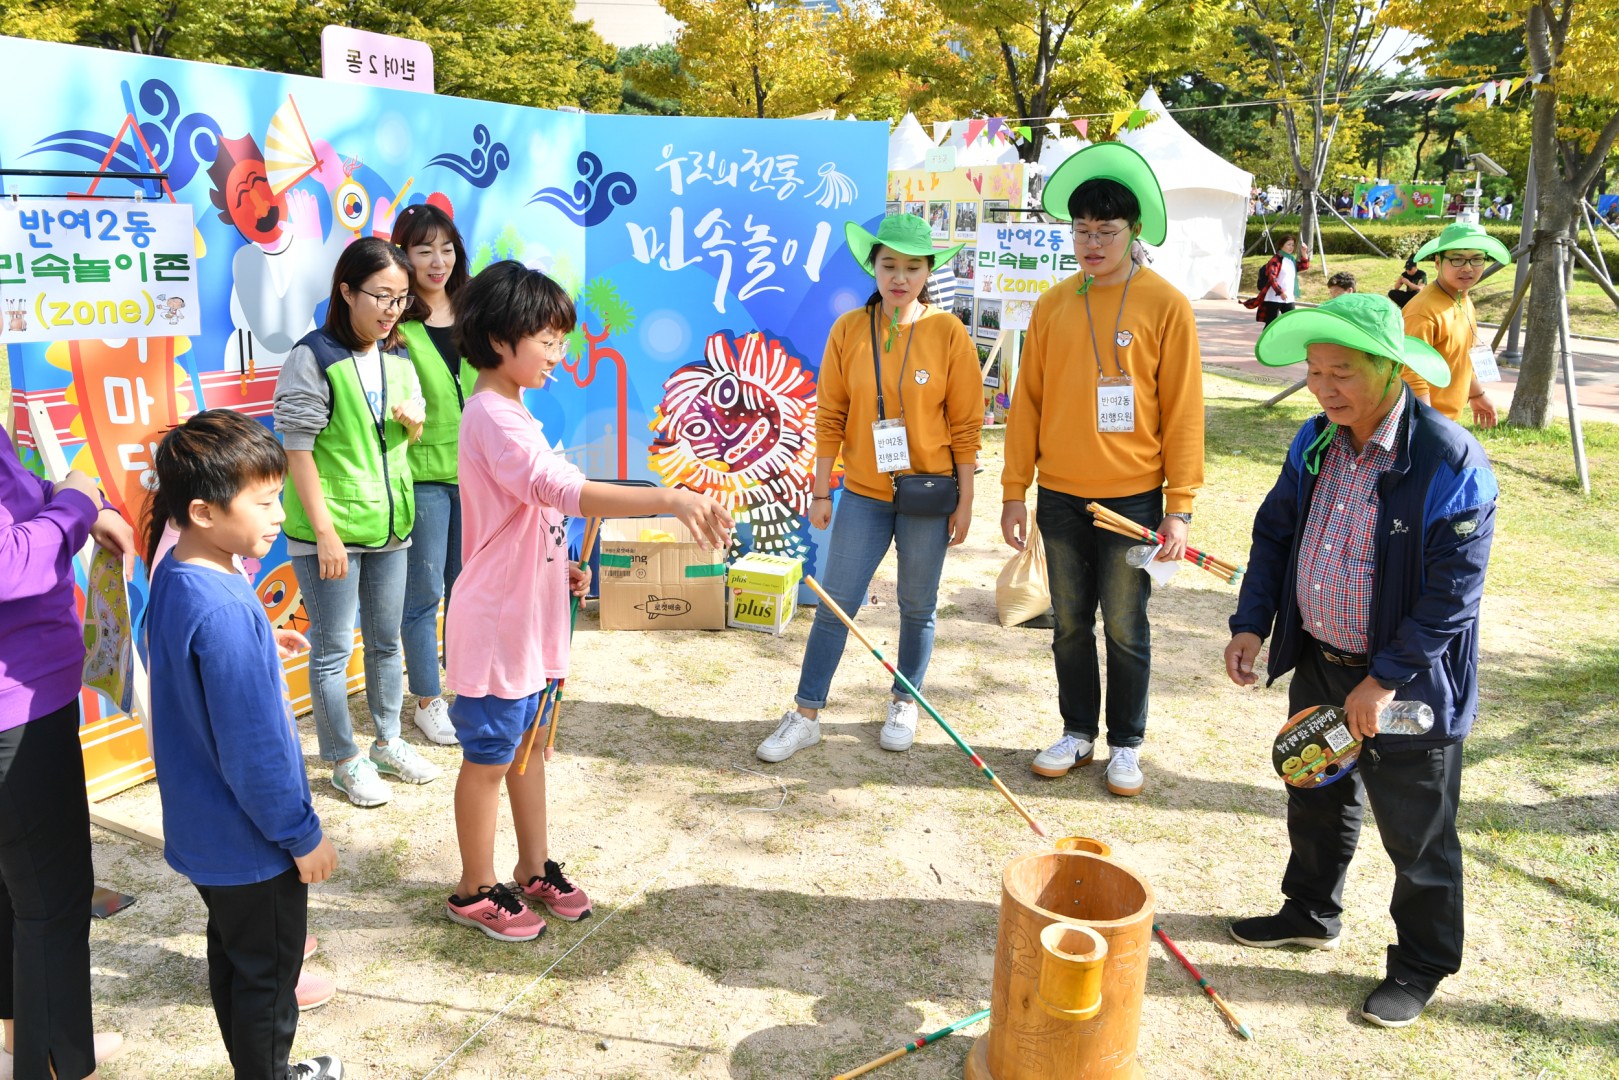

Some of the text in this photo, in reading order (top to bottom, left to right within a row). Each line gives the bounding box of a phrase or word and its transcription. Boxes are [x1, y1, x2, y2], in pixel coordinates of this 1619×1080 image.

[19, 209, 156, 248] 반여2동
[997, 228, 1064, 251] 반여2동
[0, 252, 190, 284] 민속놀이존
[625, 206, 831, 314] 민속놀이
[978, 251, 1079, 270] 민속놀이존
[35, 290, 155, 330] (zone)
[1102, 396, 1130, 406] 반여2동
[1100, 411, 1132, 423] 진행요원
[878, 435, 904, 448] 반여2동
[878, 451, 908, 464] 진행요원
[731, 575, 748, 583] plus
[654, 601, 682, 611] 로켓배송
[735, 599, 772, 618] plus
